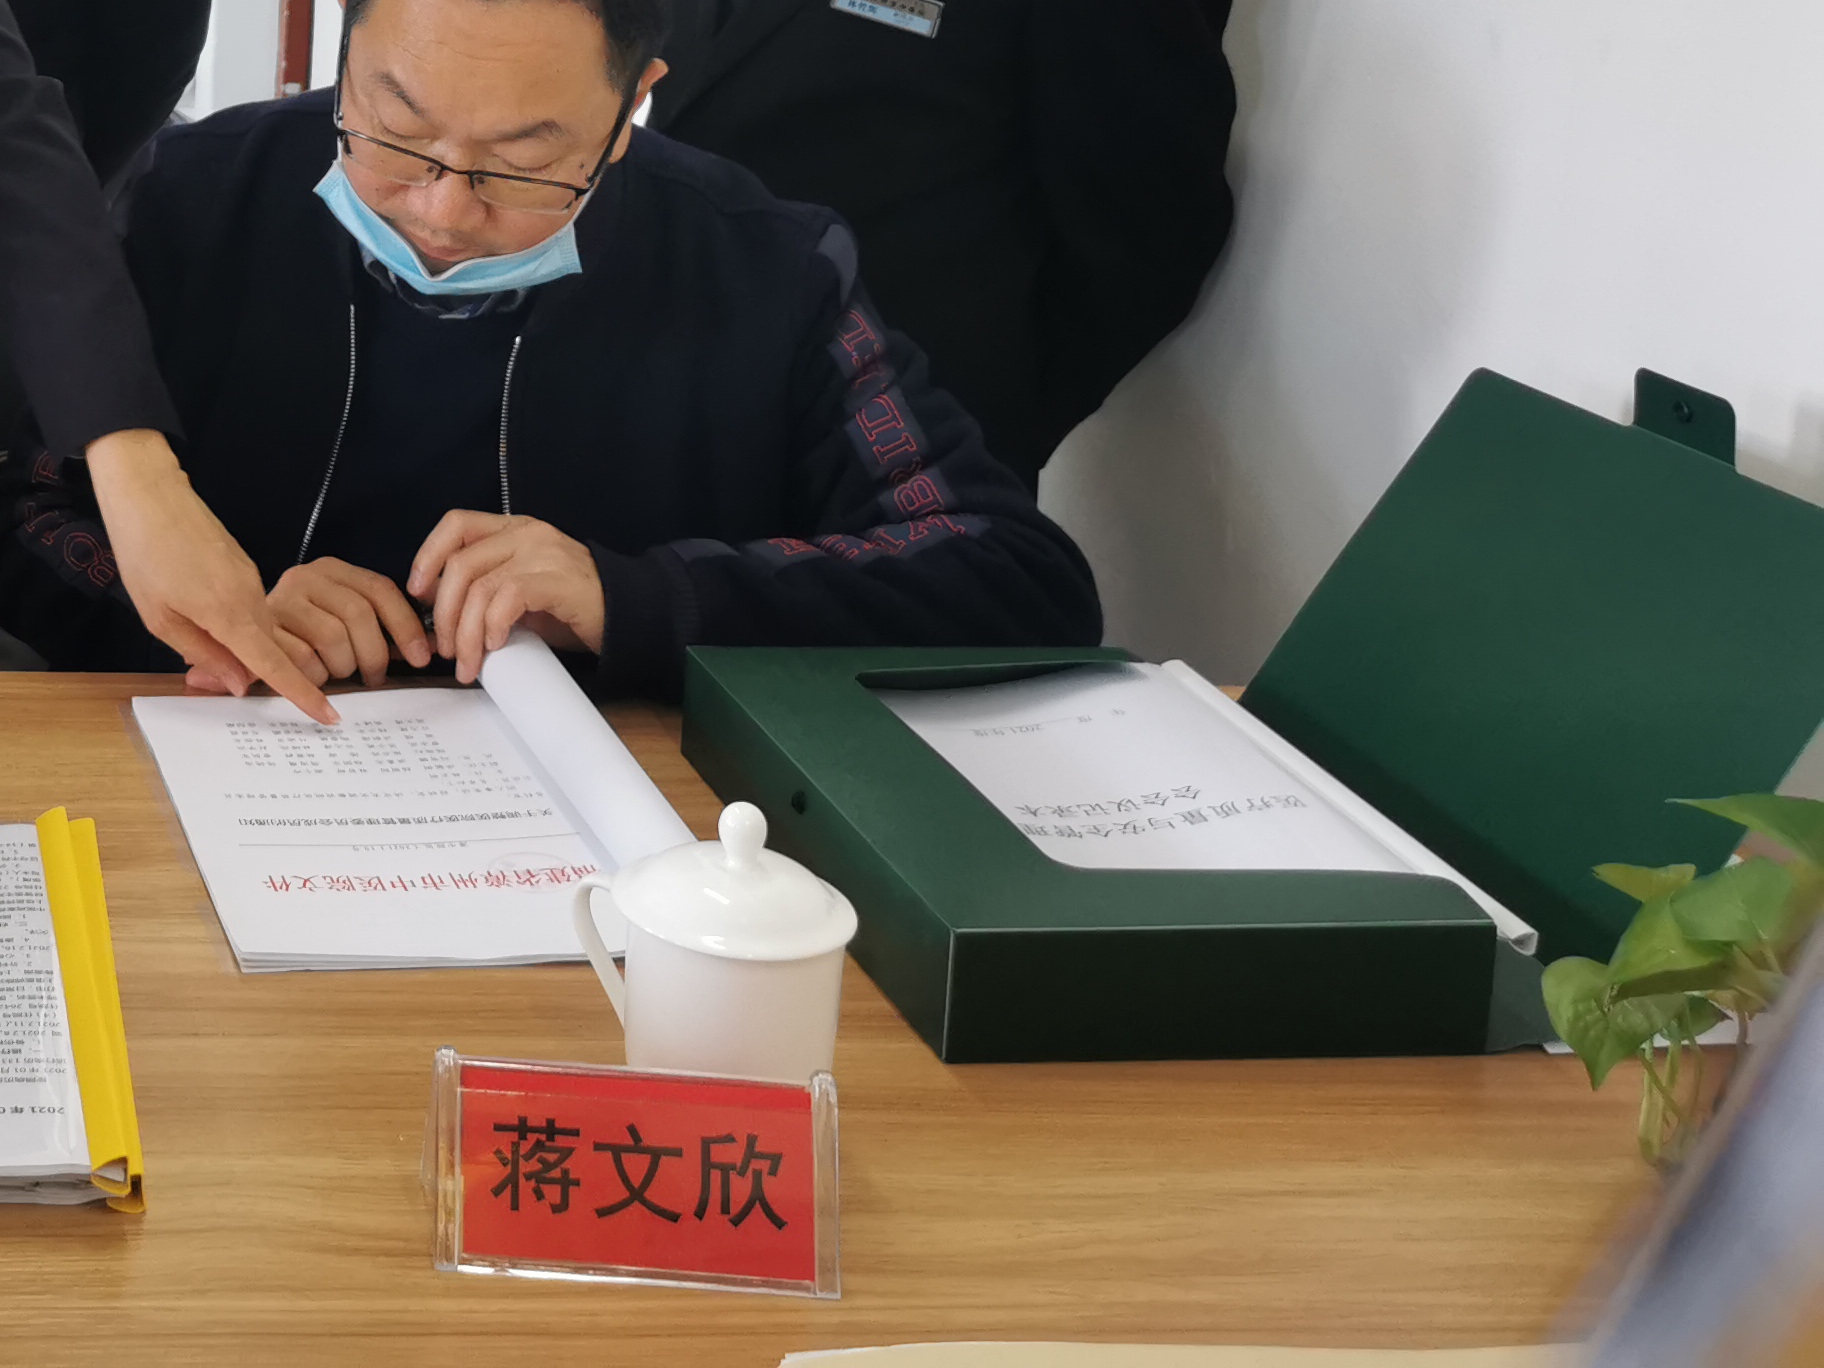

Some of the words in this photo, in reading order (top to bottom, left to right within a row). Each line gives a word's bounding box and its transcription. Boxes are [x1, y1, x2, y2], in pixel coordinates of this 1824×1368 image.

[1013, 783, 1203, 821] 会会议记录本
[1016, 790, 1309, 842] 医疗质量与安全管理
[28, 1106, 65, 1115] 2021
[489, 1114, 789, 1231] 蒋文欣
